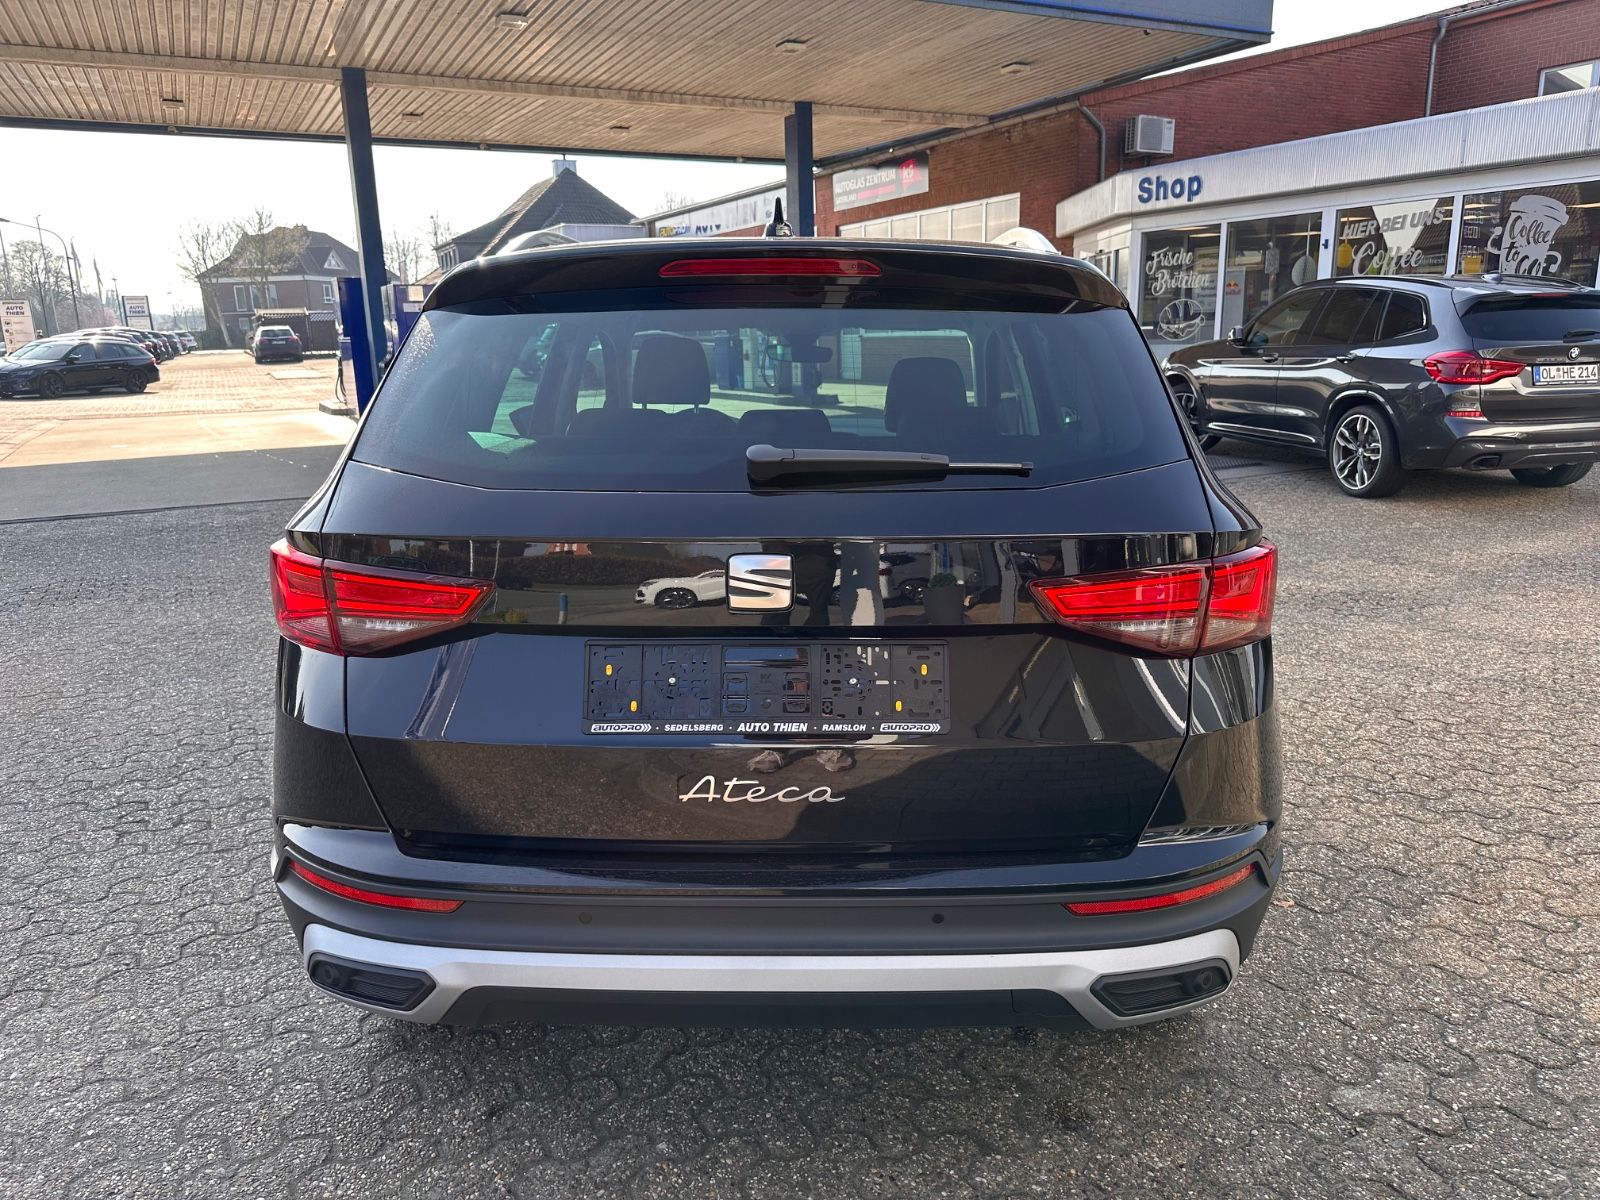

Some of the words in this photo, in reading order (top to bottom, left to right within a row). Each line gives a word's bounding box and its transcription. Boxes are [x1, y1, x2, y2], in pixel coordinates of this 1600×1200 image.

[836, 177, 866, 194] AUTOGLAS
[866, 168, 897, 187] ZENTRUM
[1138, 175, 1203, 203] Shop
[1343, 220, 1377, 238] HIER
[1379, 213, 1409, 233] BEI
[1409, 208, 1445, 228] UNS
[1509, 215, 1550, 245] Coffee
[1146, 247, 1193, 274] Frische
[1352, 241, 1424, 276] Coffee
[1504, 242, 1521, 262] to
[1152, 269, 1209, 296] Brötchen
[1541, 367, 1555, 380] OL
[1562, 367, 1576, 379] HE
[1578, 366, 1597, 379] 214
[664, 724, 724, 732] SEDELSBERG
[737, 722, 770, 732] AUTO
[773, 722, 808, 732] THIEN
[822, 724, 867, 732] RAMSLOH
[679, 775, 846, 803] Ateca
